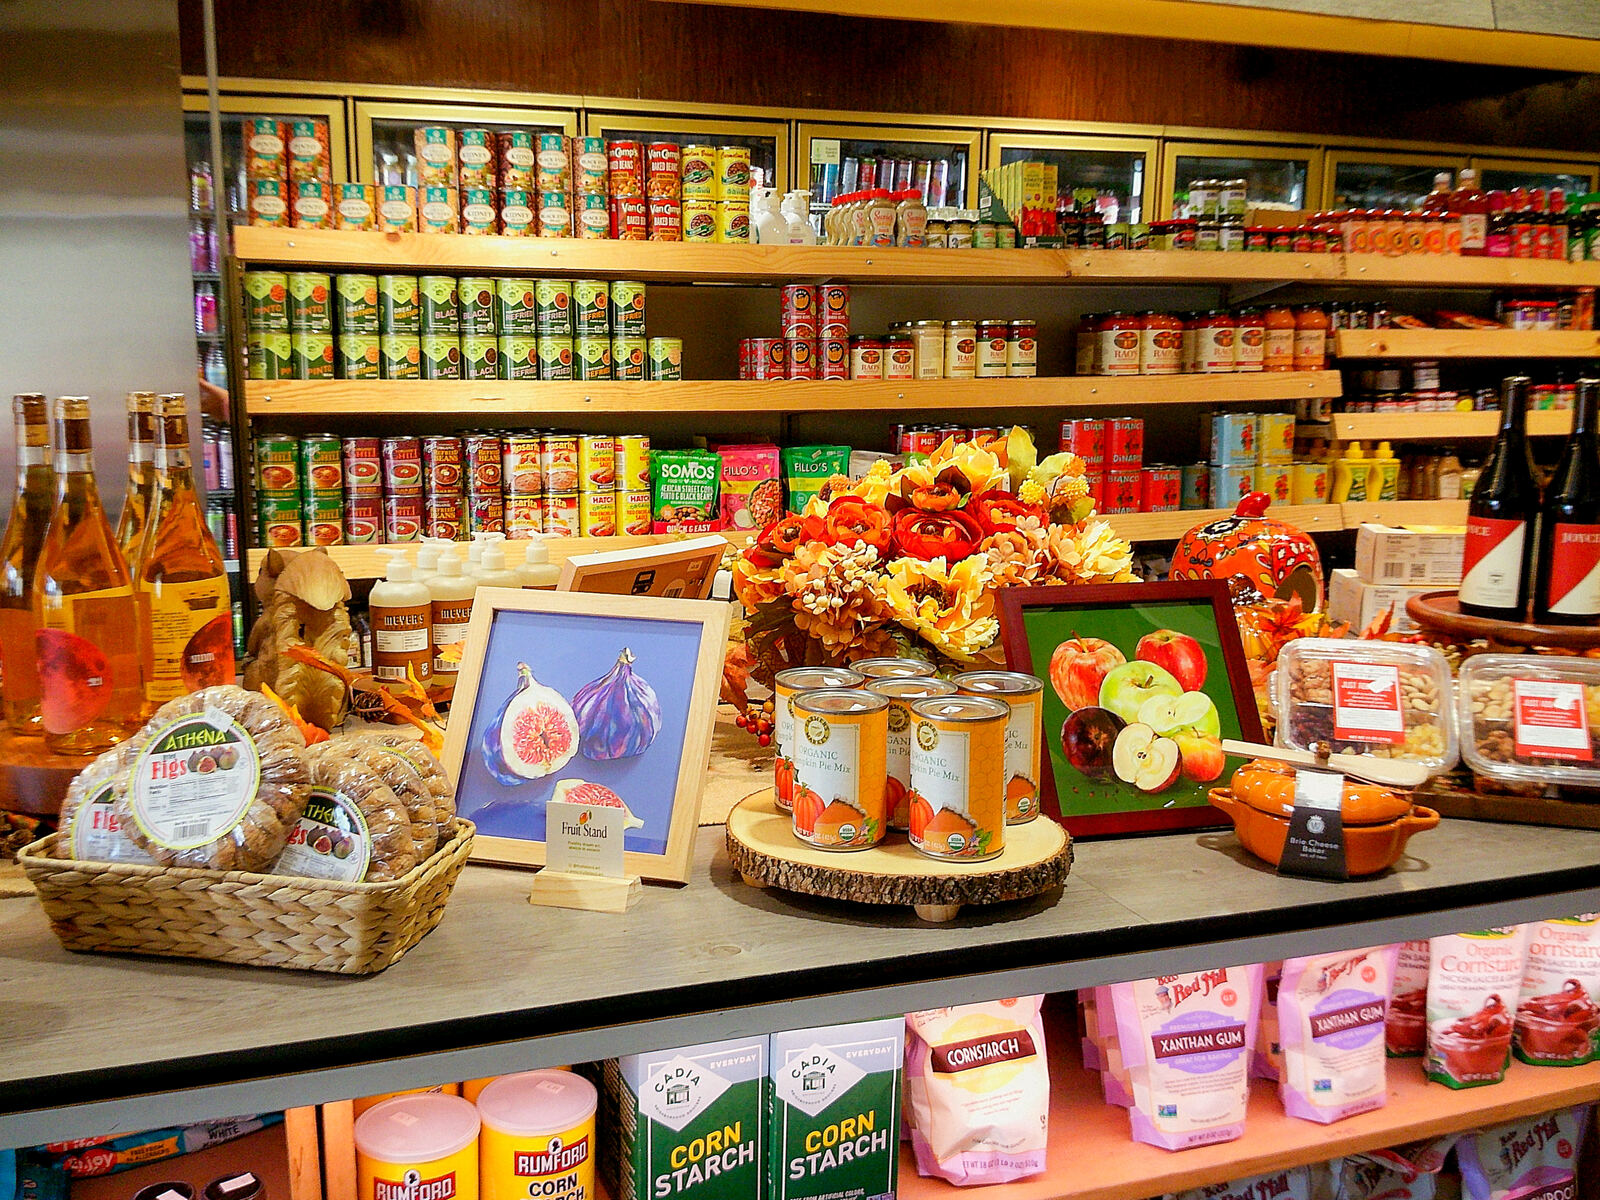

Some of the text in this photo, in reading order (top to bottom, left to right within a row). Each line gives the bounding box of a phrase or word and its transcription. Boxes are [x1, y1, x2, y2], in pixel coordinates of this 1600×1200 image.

[648, 148, 680, 160] Van Camp
[619, 160, 633, 170] BEANS
[651, 162, 665, 172] BAKED
[621, 203, 636, 213] Van
[650, 204, 680, 214] Van Camp
[627, 216, 640, 225] BAKED
[654, 217, 668, 226] BAKED
[253, 304, 281, 315] PINTO
[296, 305, 323, 315] PINTO
[347, 304, 366, 312] GREAT
[394, 305, 412, 313] GREAT
[435, 310, 457, 319] BLAC
[463, 309, 488, 319] BLACK
[538, 312, 566, 321] REFRIED
[580, 311, 605, 321] REFRIED
[618, 312, 642, 322] REFRIED
[1115, 350, 1138, 358] RAO'S
[306, 365, 333, 374] PINTO
[347, 363, 366, 371] GREAT
[433, 366, 457, 377] BLACK
[470, 367, 494, 377] BLACK
[542, 367, 570, 378] REFRIED
[616, 366, 640, 377] REFRIED
[545, 441, 575, 451] Rosarita
[594, 441, 613, 449] HATC
[661, 463, 715, 480] SOMOS
[723, 465, 759, 476] FILLO'S
[794, 462, 828, 473] FILLO'S
[1108, 475, 1140, 483] BIANCO
[682, 485, 700, 493] STREET
[701, 486, 714, 494] CORN
[661, 491, 713, 501] PINTO BLACK BEANS
[694, 524, 711, 532] EASY
[441, 607, 472, 619] MEYER
[384, 613, 425, 626] MEYER'S
[1341, 681, 1357, 689] JUST
[164, 728, 227, 751] ATHENA
[887, 735, 911, 745] GANI
[1014, 741, 1028, 750] Mix
[799, 745, 839, 760] ORGANIC
[151, 759, 188, 780] Figs
[819, 760, 851, 774] Pie Mix
[928, 768, 960, 783] Pie Mix
[562, 821, 608, 838] Fruit Stand
[1290, 837, 1339, 850] Brie Cheese
[1302, 845, 1325, 854] Baker
[1540, 926, 1589, 944] Organic
[1466, 943, 1512, 959] Organic
[1529, 942, 1600, 958] ornstar
[1440, 955, 1520, 973] Cornstar
[1172, 976, 1201, 1008] Red
[1201, 968, 1228, 997] Mill
[1316, 1005, 1384, 1032] XANTHAN GUM
[1160, 1030, 1242, 1053] XANTHAN GUM
[845, 1046, 892, 1059] EVERYDAY
[946, 1037, 1019, 1067] CORNSTARCH
[709, 1054, 757, 1070] EVERYDAY
[791, 1055, 836, 1079] CADIA
[654, 1068, 701, 1093] CADIA
[210, 1125, 240, 1140] WHITE
[805, 1109, 876, 1153] CORN
[670, 1120, 742, 1168] CORN
[1511, 1130, 1536, 1167] Red
[517, 1143, 587, 1174] RUMFORD
[788, 1128, 889, 1180] STARCH
[654, 1140, 755, 1198] STARCH
[376, 1178, 454, 1200] RUMFORD
[528, 1173, 578, 1197] CORN
[1255, 1173, 1291, 1200] Mill
